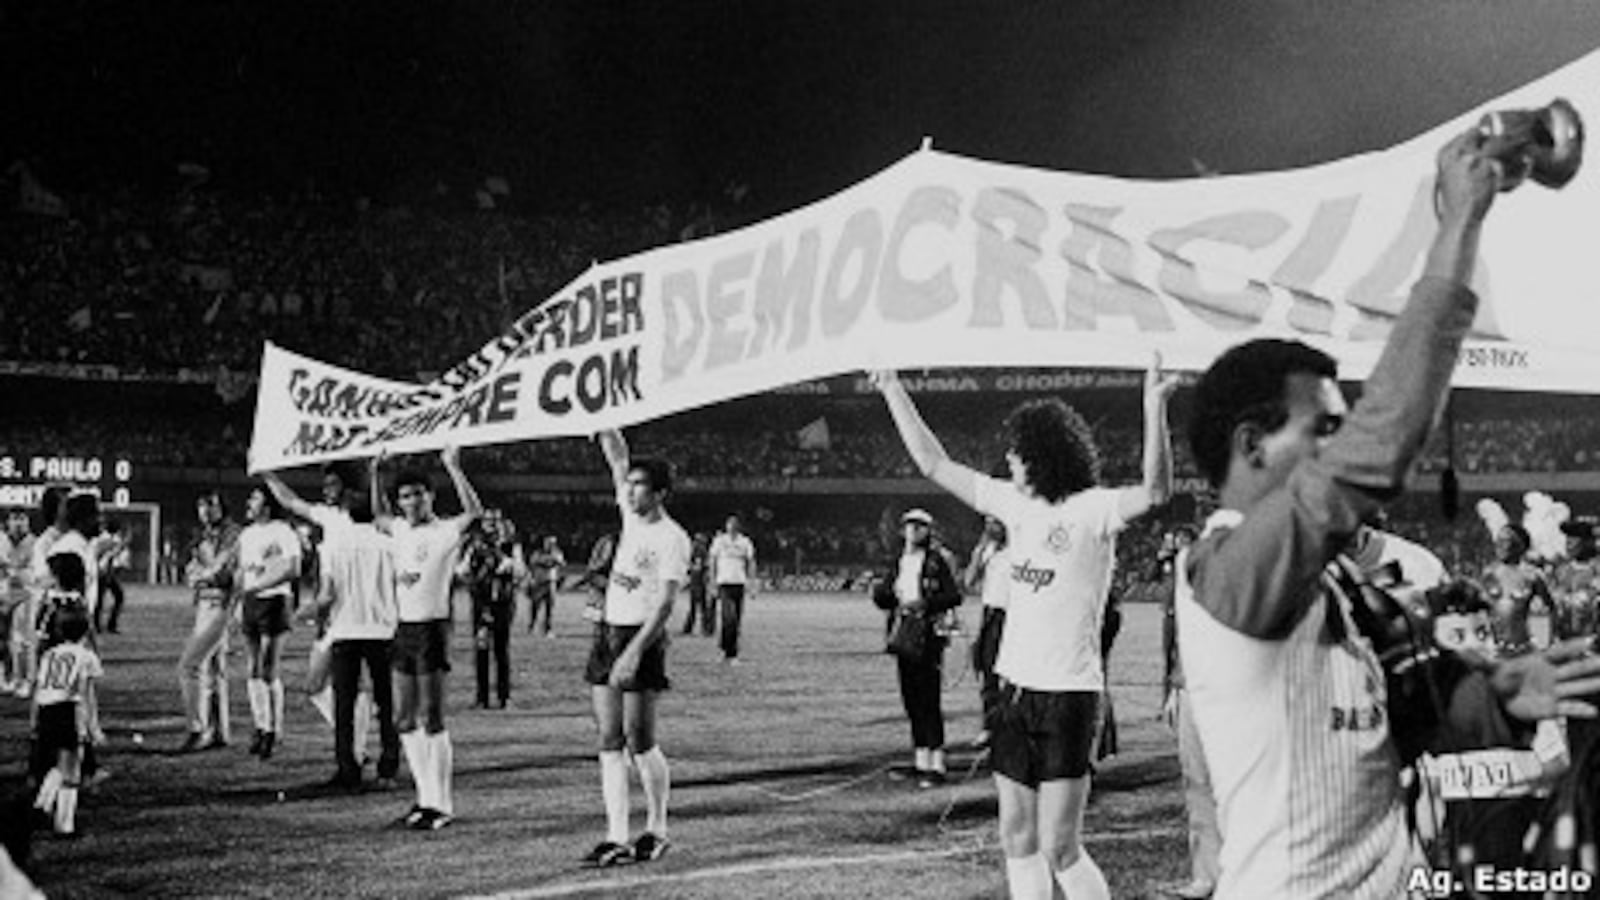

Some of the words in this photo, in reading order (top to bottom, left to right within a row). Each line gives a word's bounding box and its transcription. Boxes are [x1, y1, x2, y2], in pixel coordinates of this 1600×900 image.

[660, 173, 1509, 383] DEMOCRACIA
[538, 344, 643, 416] COM
[30, 456, 102, 481] PAULO
[115, 459, 130, 481] 0
[115, 487, 130, 509] 0
